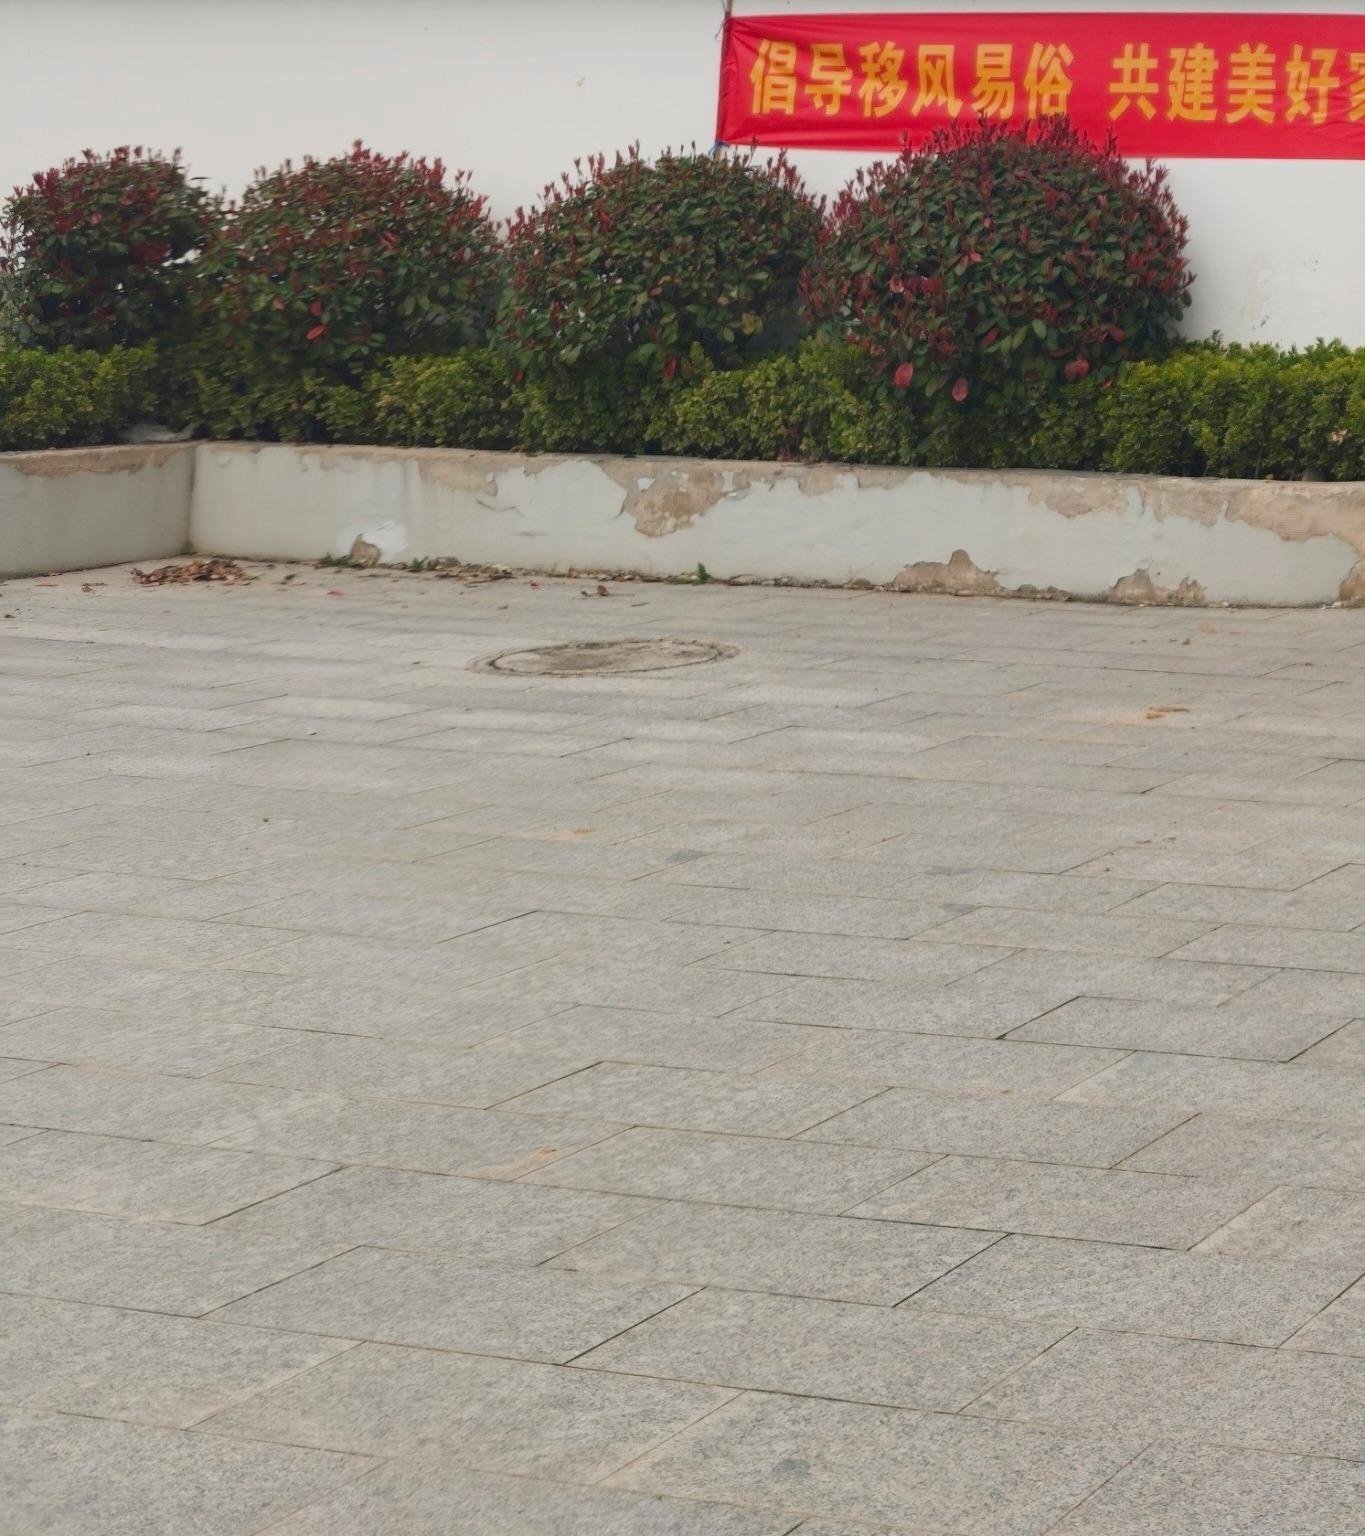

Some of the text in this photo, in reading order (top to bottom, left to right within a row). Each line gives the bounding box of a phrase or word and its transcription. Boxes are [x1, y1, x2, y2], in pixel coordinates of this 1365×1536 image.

[749, 40, 1074, 119] 倡导移风易俗
